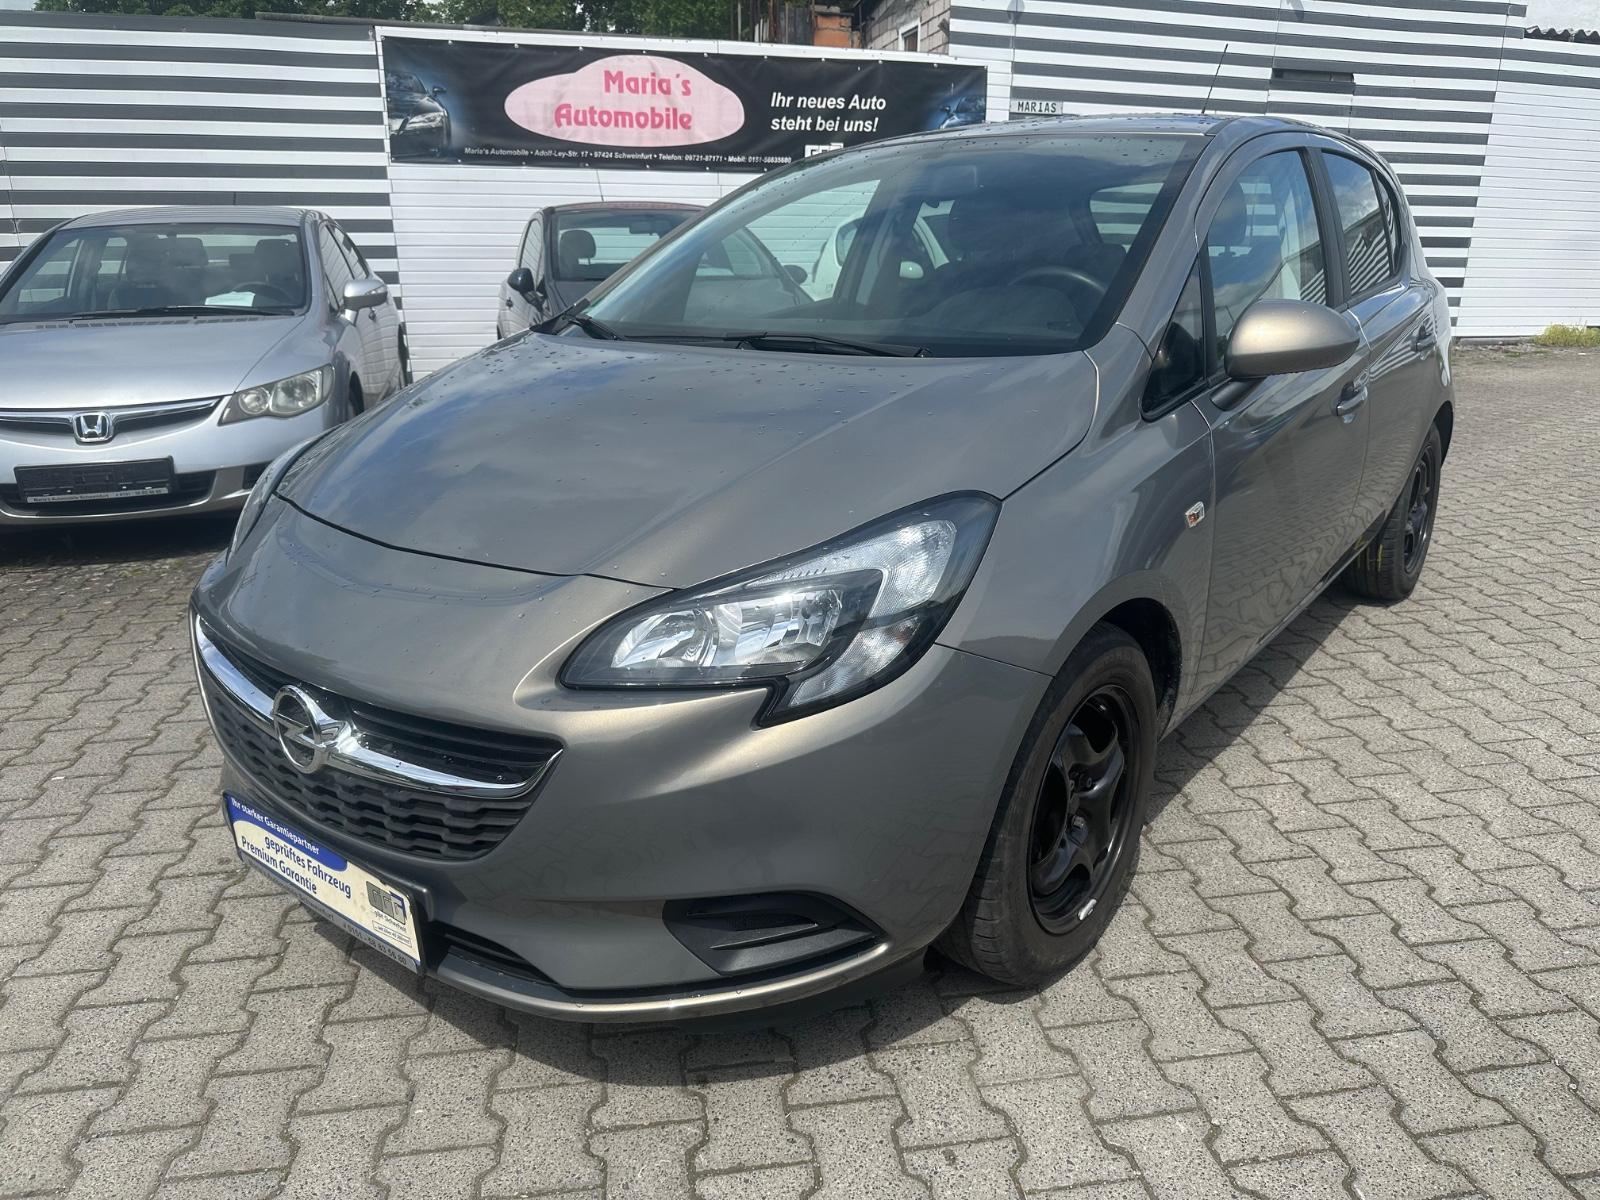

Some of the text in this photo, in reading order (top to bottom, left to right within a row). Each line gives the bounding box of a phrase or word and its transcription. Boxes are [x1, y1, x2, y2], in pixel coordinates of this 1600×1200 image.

[770, 91, 887, 110] Ihr neues Auto
[1017, 101, 1057, 113] MARIAS
[554, 103, 693, 130] Automobile
[770, 115, 879, 132] steht bei uns!
[464, 147, 489, 155] Maria's
[490, 148, 529, 156] Automobile
[581, 150, 588, 158] 17
[614, 152, 652, 160] Schweinfurt
[658, 153, 683, 161] Telefon:
[241, 804, 264, 823] starker
[264, 816, 320, 855] Garantiepartner
[241, 836, 318, 895] Premium Garantie
[264, 836, 352, 899] geprüftes Fahrzeug
